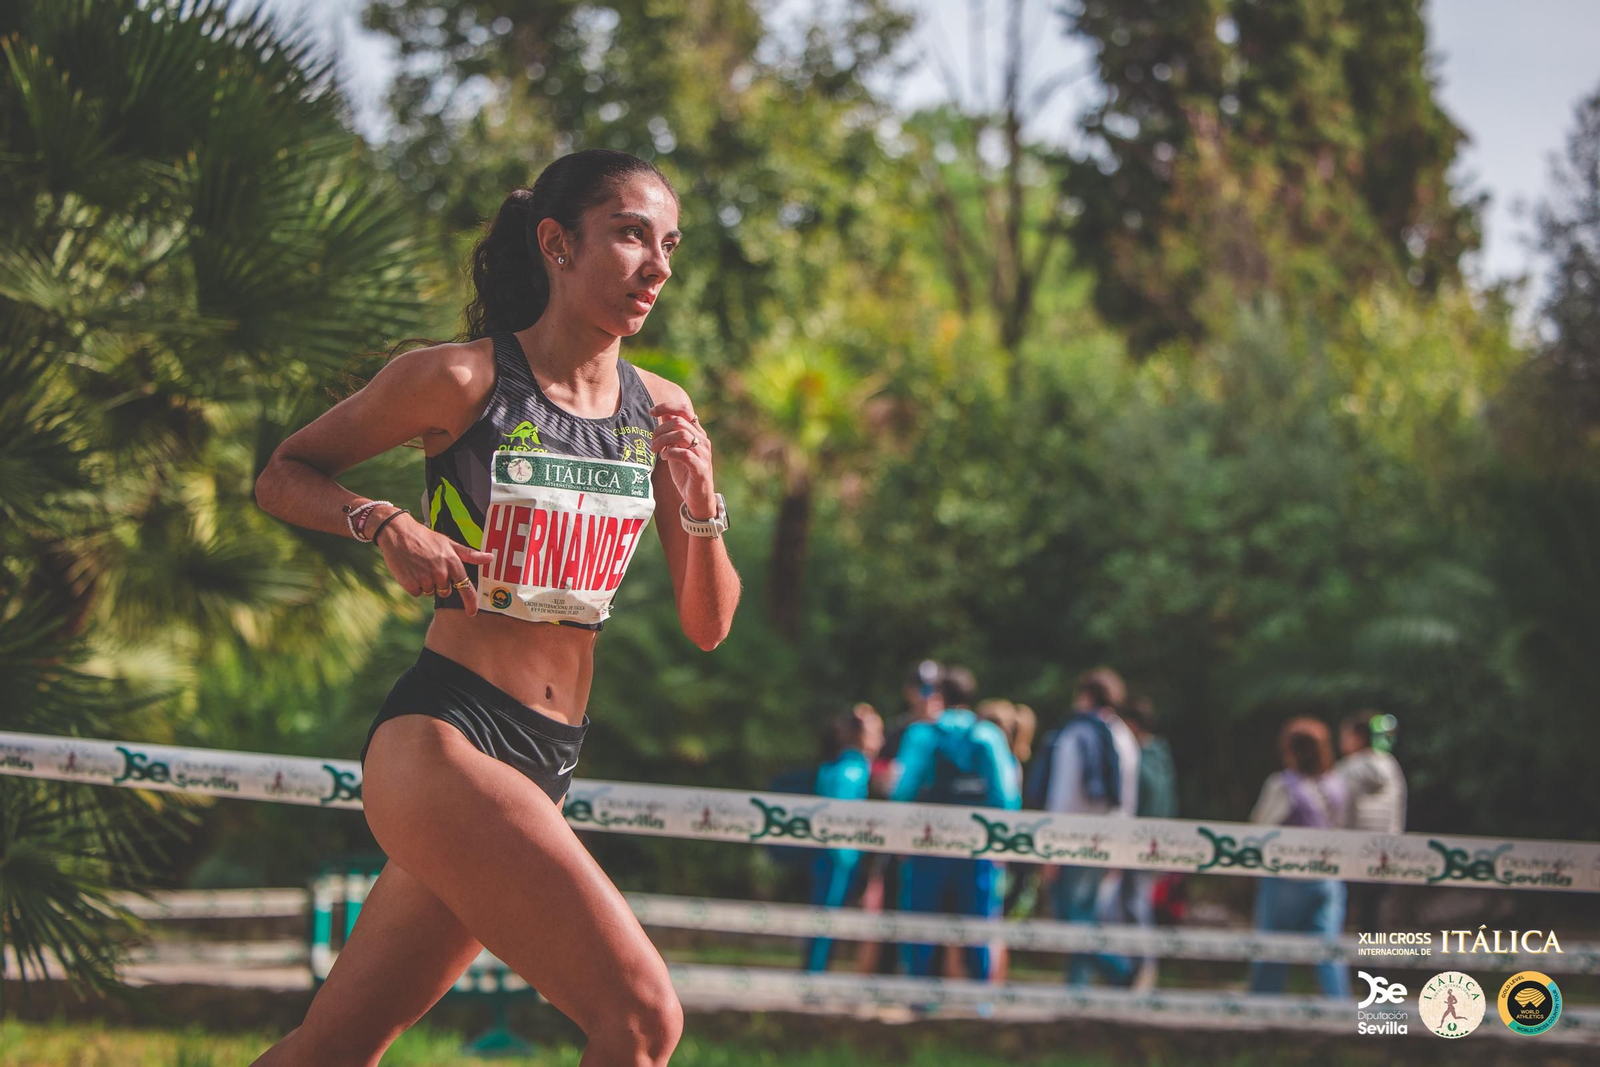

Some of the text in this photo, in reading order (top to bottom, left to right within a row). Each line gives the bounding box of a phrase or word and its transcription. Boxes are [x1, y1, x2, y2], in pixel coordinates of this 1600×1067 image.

[612, 426, 653, 439] CLUB ATLETIS
[545, 463, 621, 489] ITÁLICA
[482, 493, 645, 591] HERNÁNDEZ
